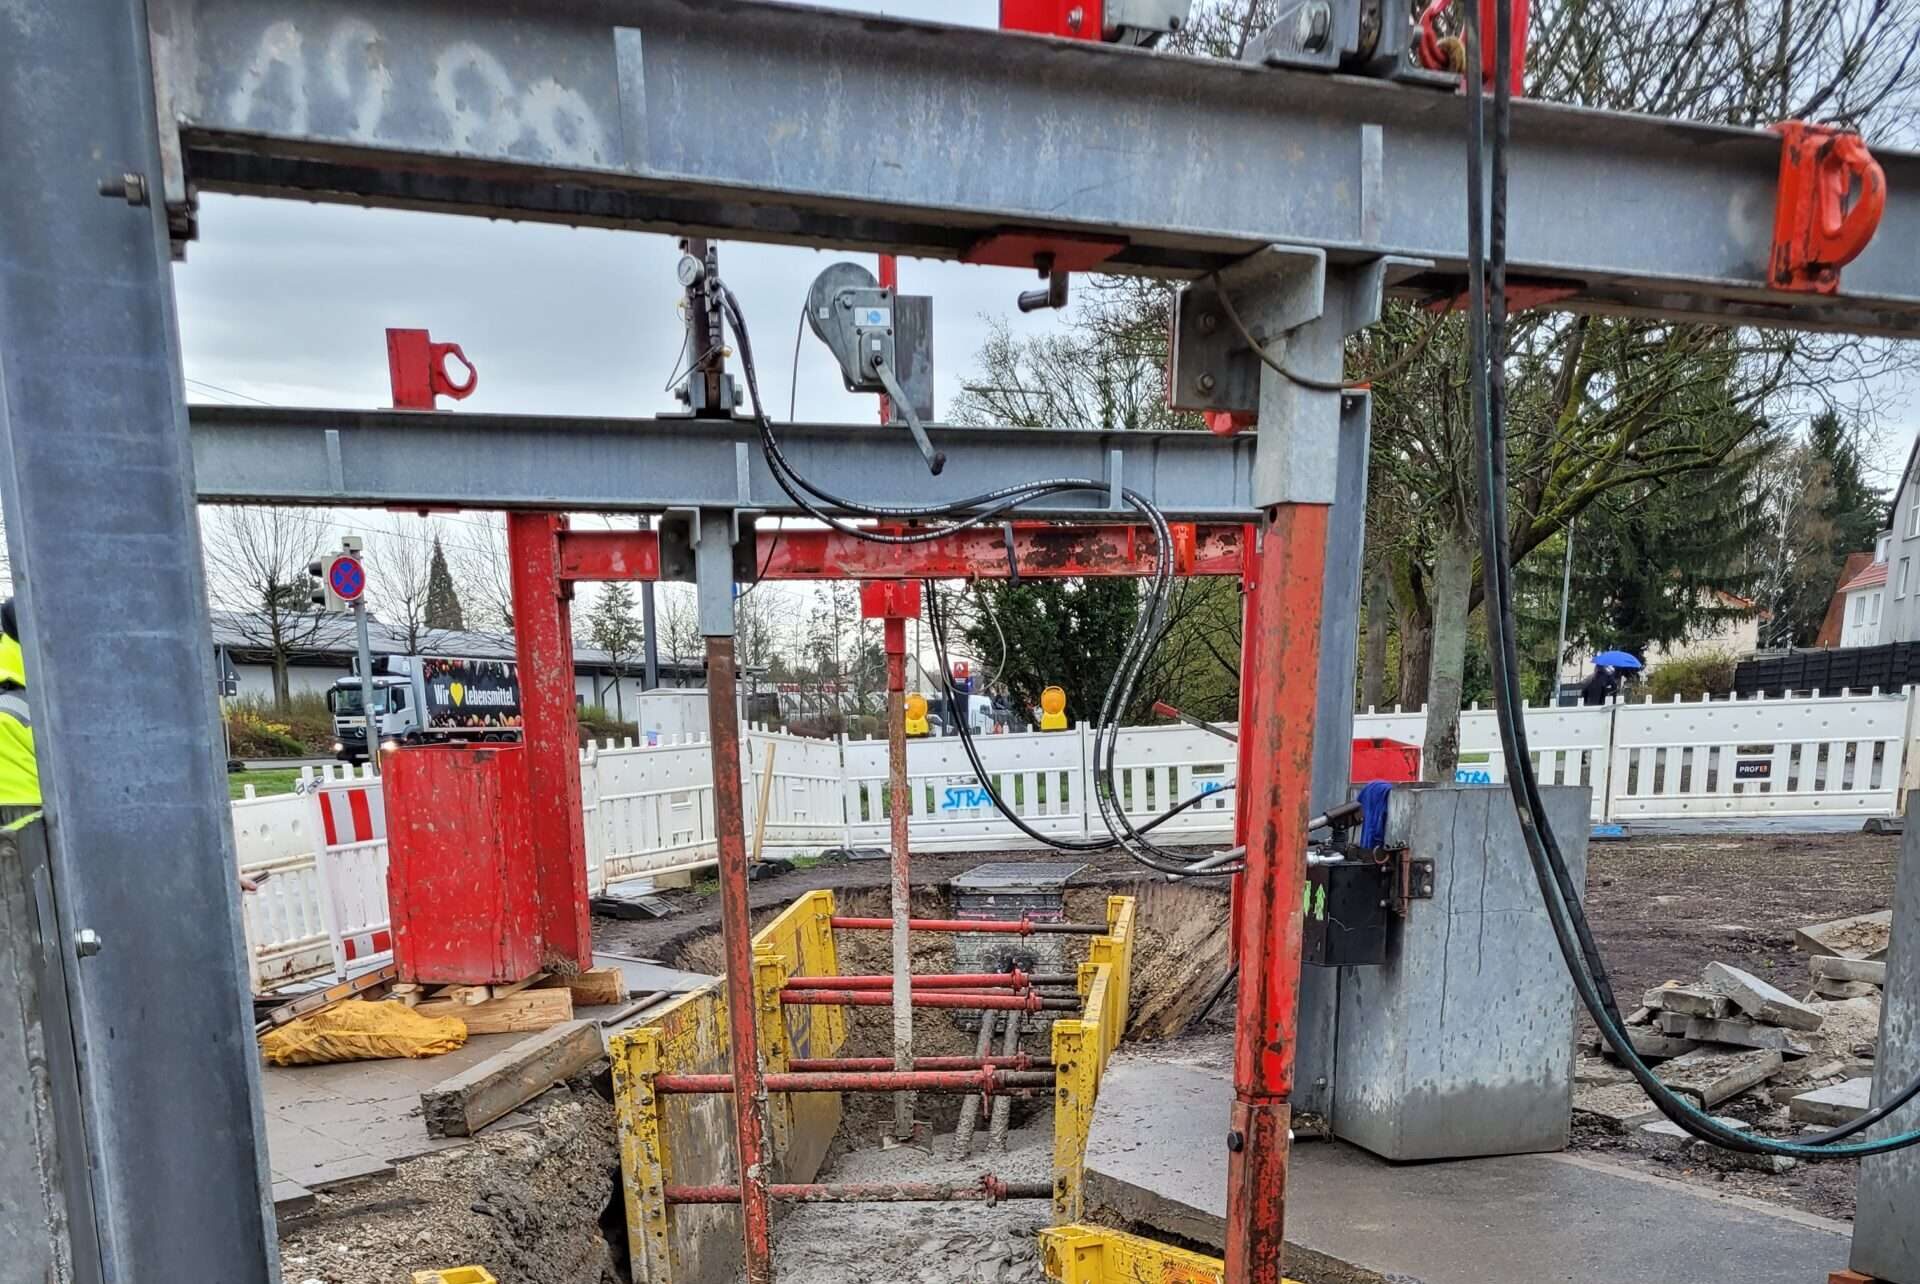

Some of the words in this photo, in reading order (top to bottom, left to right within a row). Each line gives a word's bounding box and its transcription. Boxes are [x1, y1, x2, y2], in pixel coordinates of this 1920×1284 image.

[433, 683, 450, 705] Wir
[463, 684, 516, 706] Lebensmittel.
[942, 787, 992, 809] STRA
